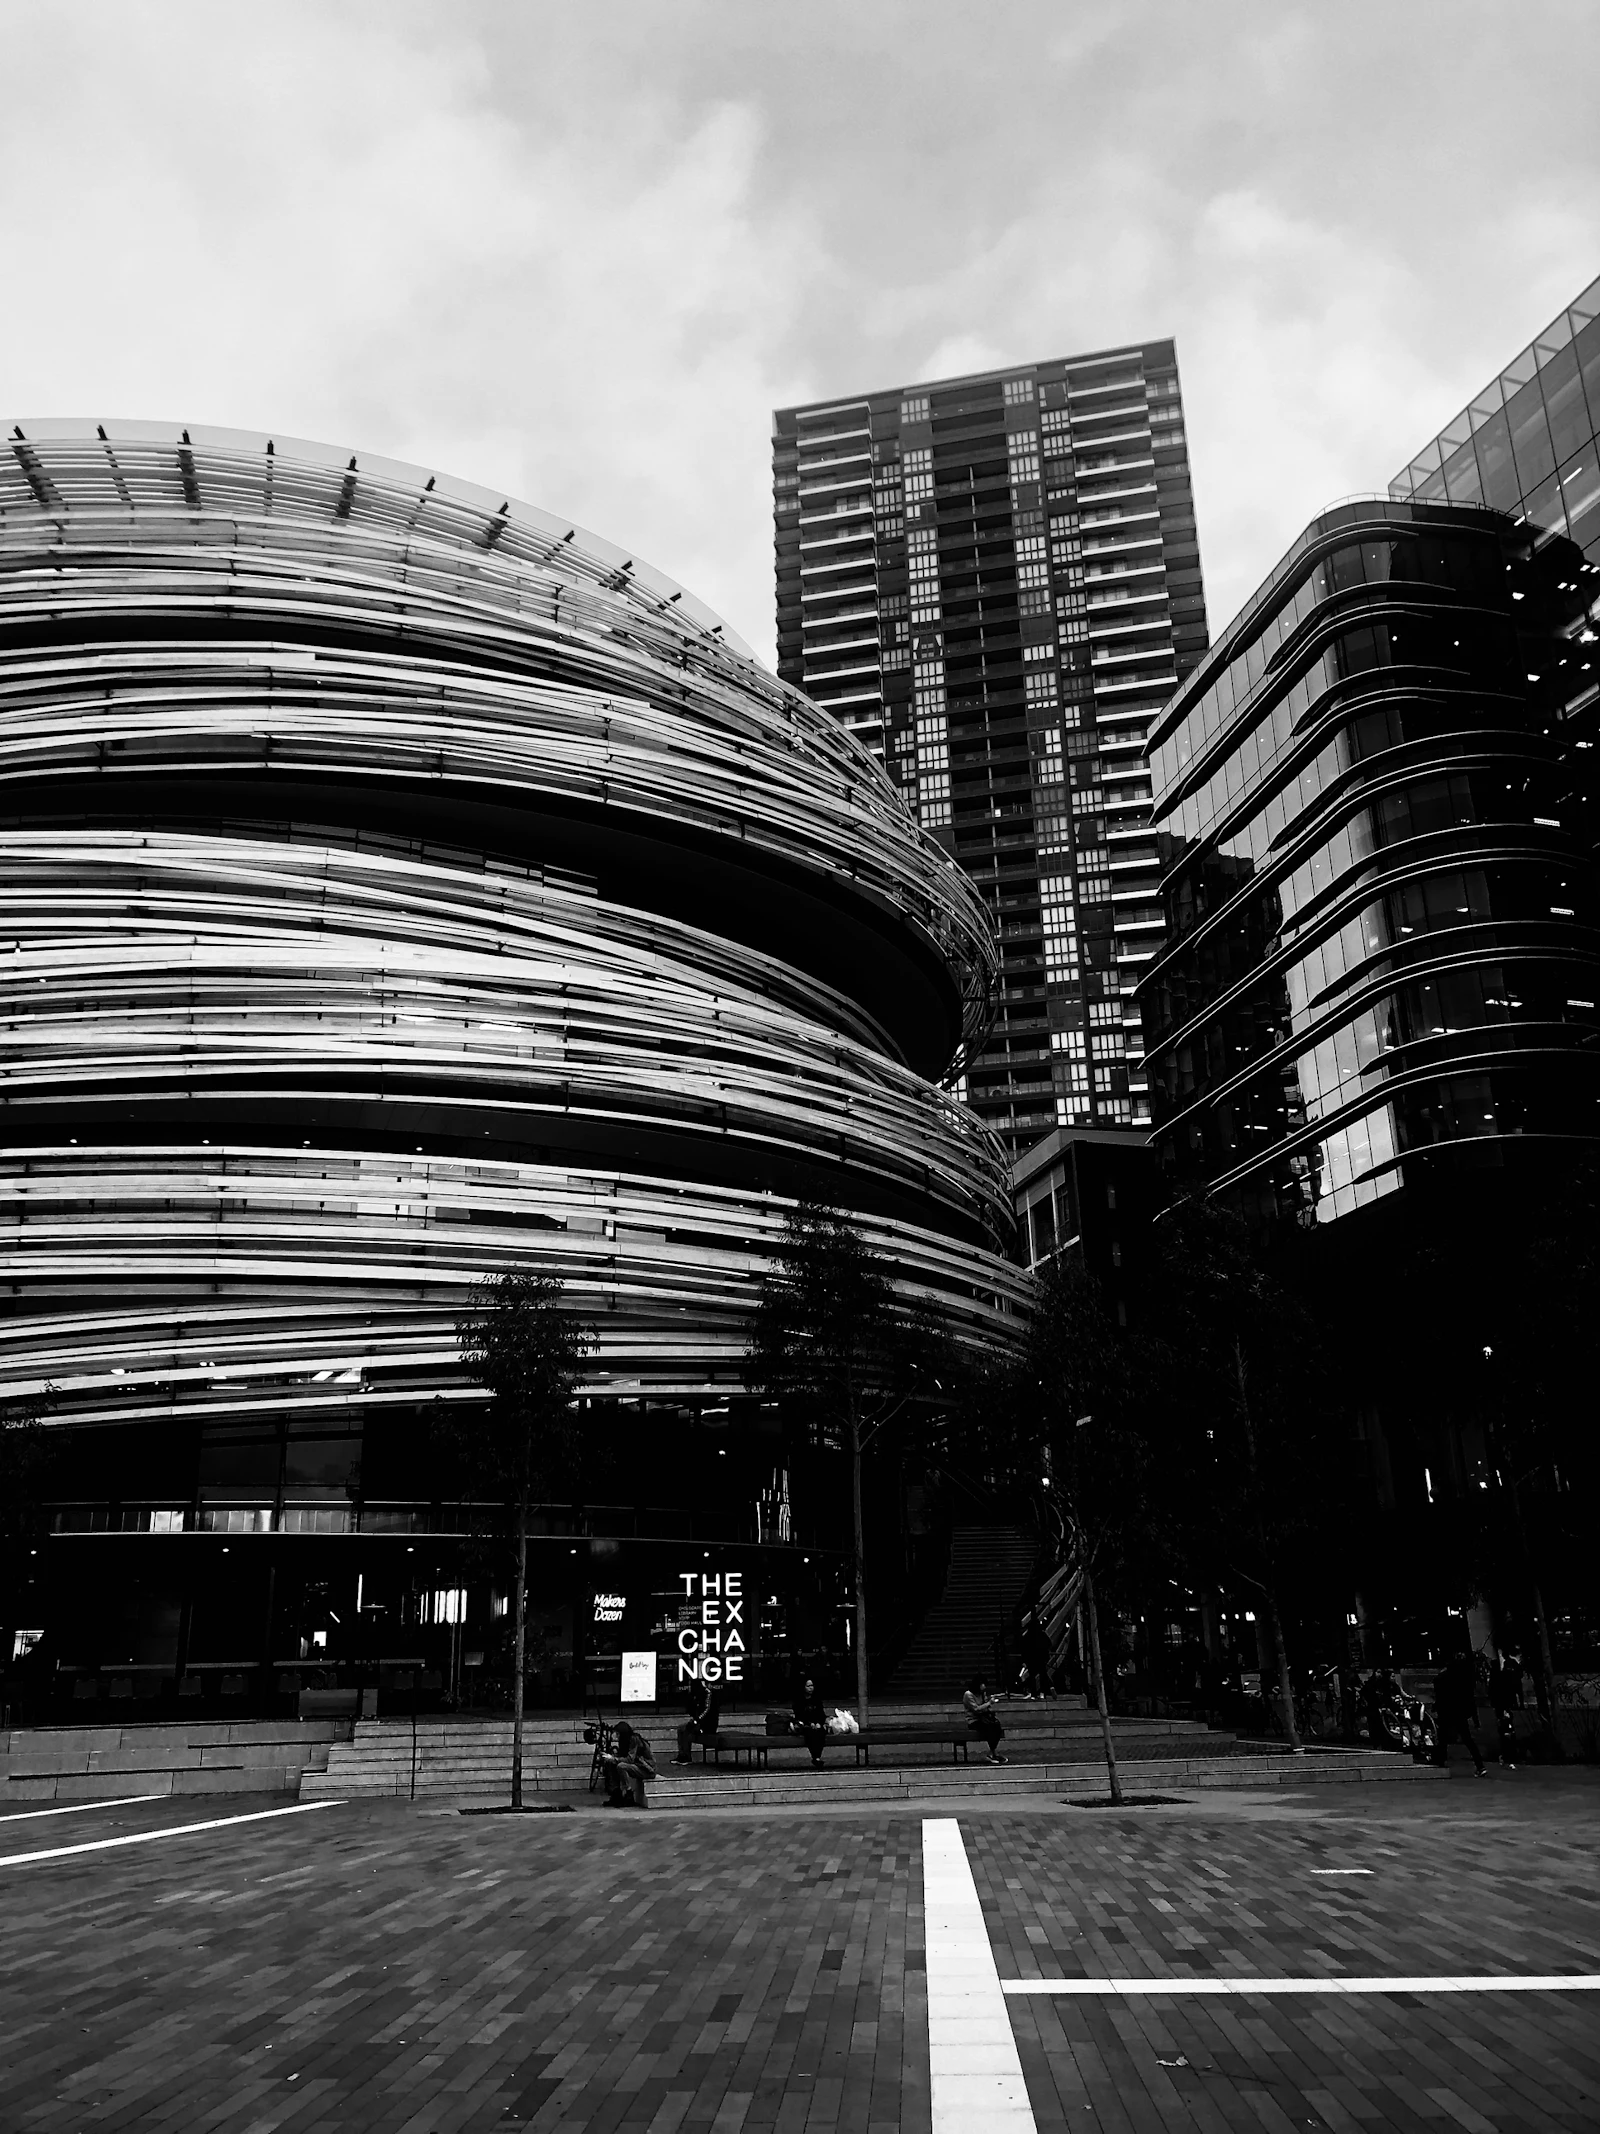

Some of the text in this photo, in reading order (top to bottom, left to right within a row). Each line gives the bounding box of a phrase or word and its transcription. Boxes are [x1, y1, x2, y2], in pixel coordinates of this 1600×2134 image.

[679, 1573, 742, 1597] THE
[594, 1593, 627, 1608] Makers
[594, 1607, 623, 1621] Dozen
[703, 1601, 743, 1624] EX
[678, 1629, 745, 1653] CHA
[679, 1656, 743, 1682] NGE
